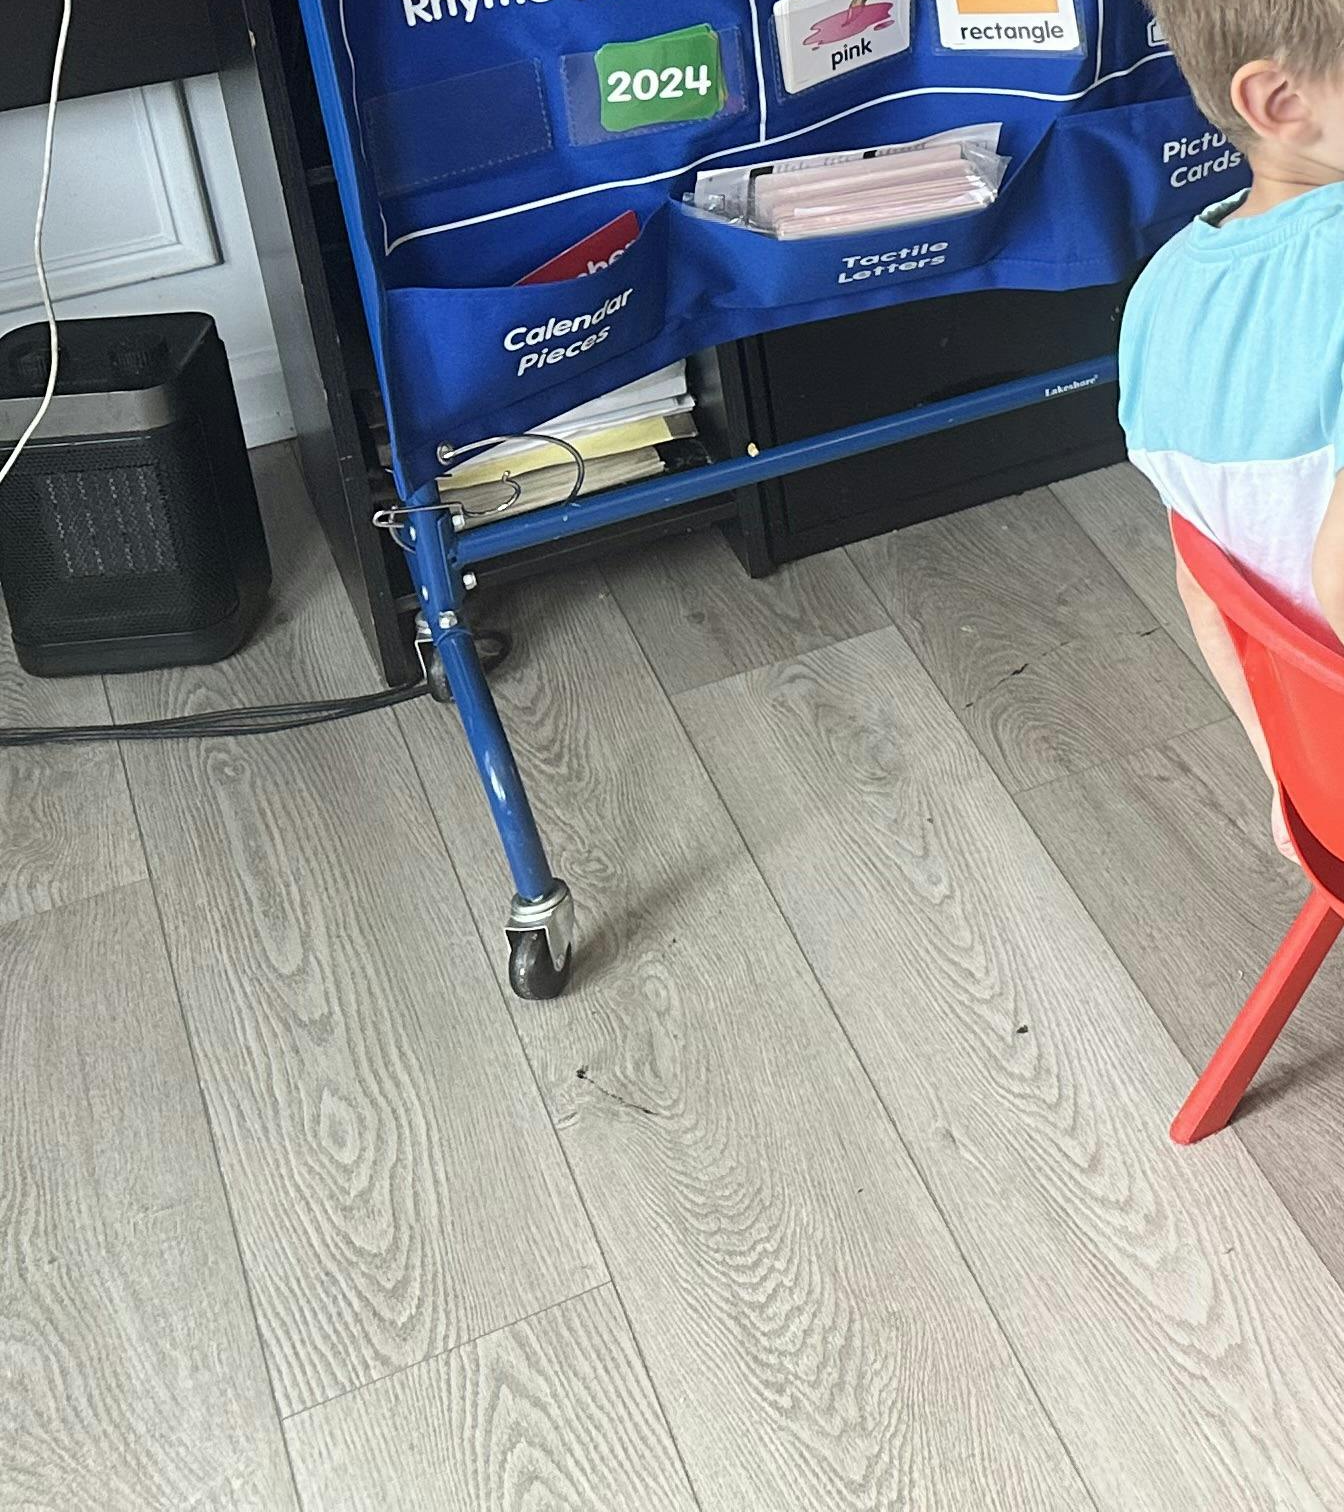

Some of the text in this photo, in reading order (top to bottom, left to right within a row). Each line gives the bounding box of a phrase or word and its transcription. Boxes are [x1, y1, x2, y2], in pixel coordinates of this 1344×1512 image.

[960, 20, 1064, 44] rectangle
[831, 37, 872, 70] pink
[606, 64, 712, 103] 2024
[1163, 132, 1227, 163] Pictu
[1170, 150, 1242, 188] Cards
[837, 254, 946, 284] Letters
[842, 241, 949, 269] Tactile
[503, 288, 633, 352] Calendar
[517, 326, 611, 377] Pieces
